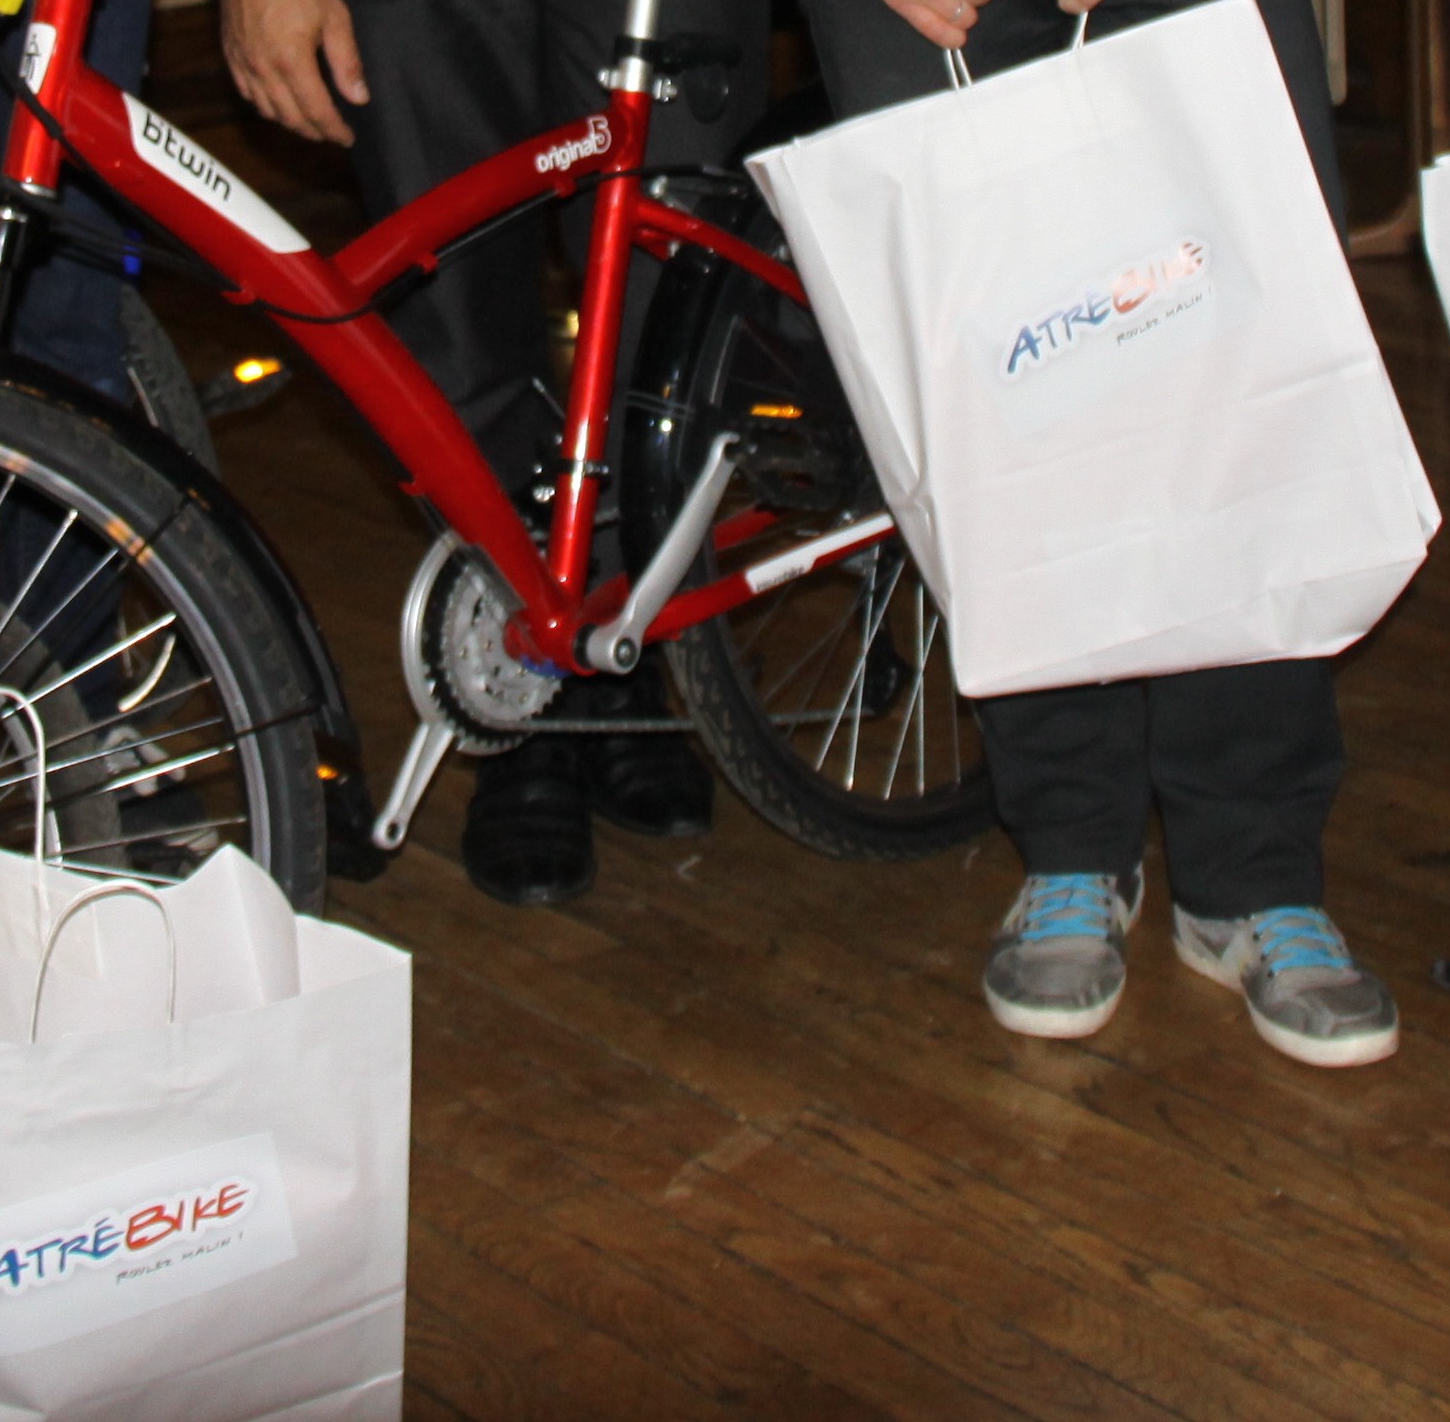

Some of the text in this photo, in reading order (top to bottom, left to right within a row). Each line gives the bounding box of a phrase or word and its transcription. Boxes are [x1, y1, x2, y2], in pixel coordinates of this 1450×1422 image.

[143, 110, 232, 203] btwin
[534, 114, 613, 174] original 5
